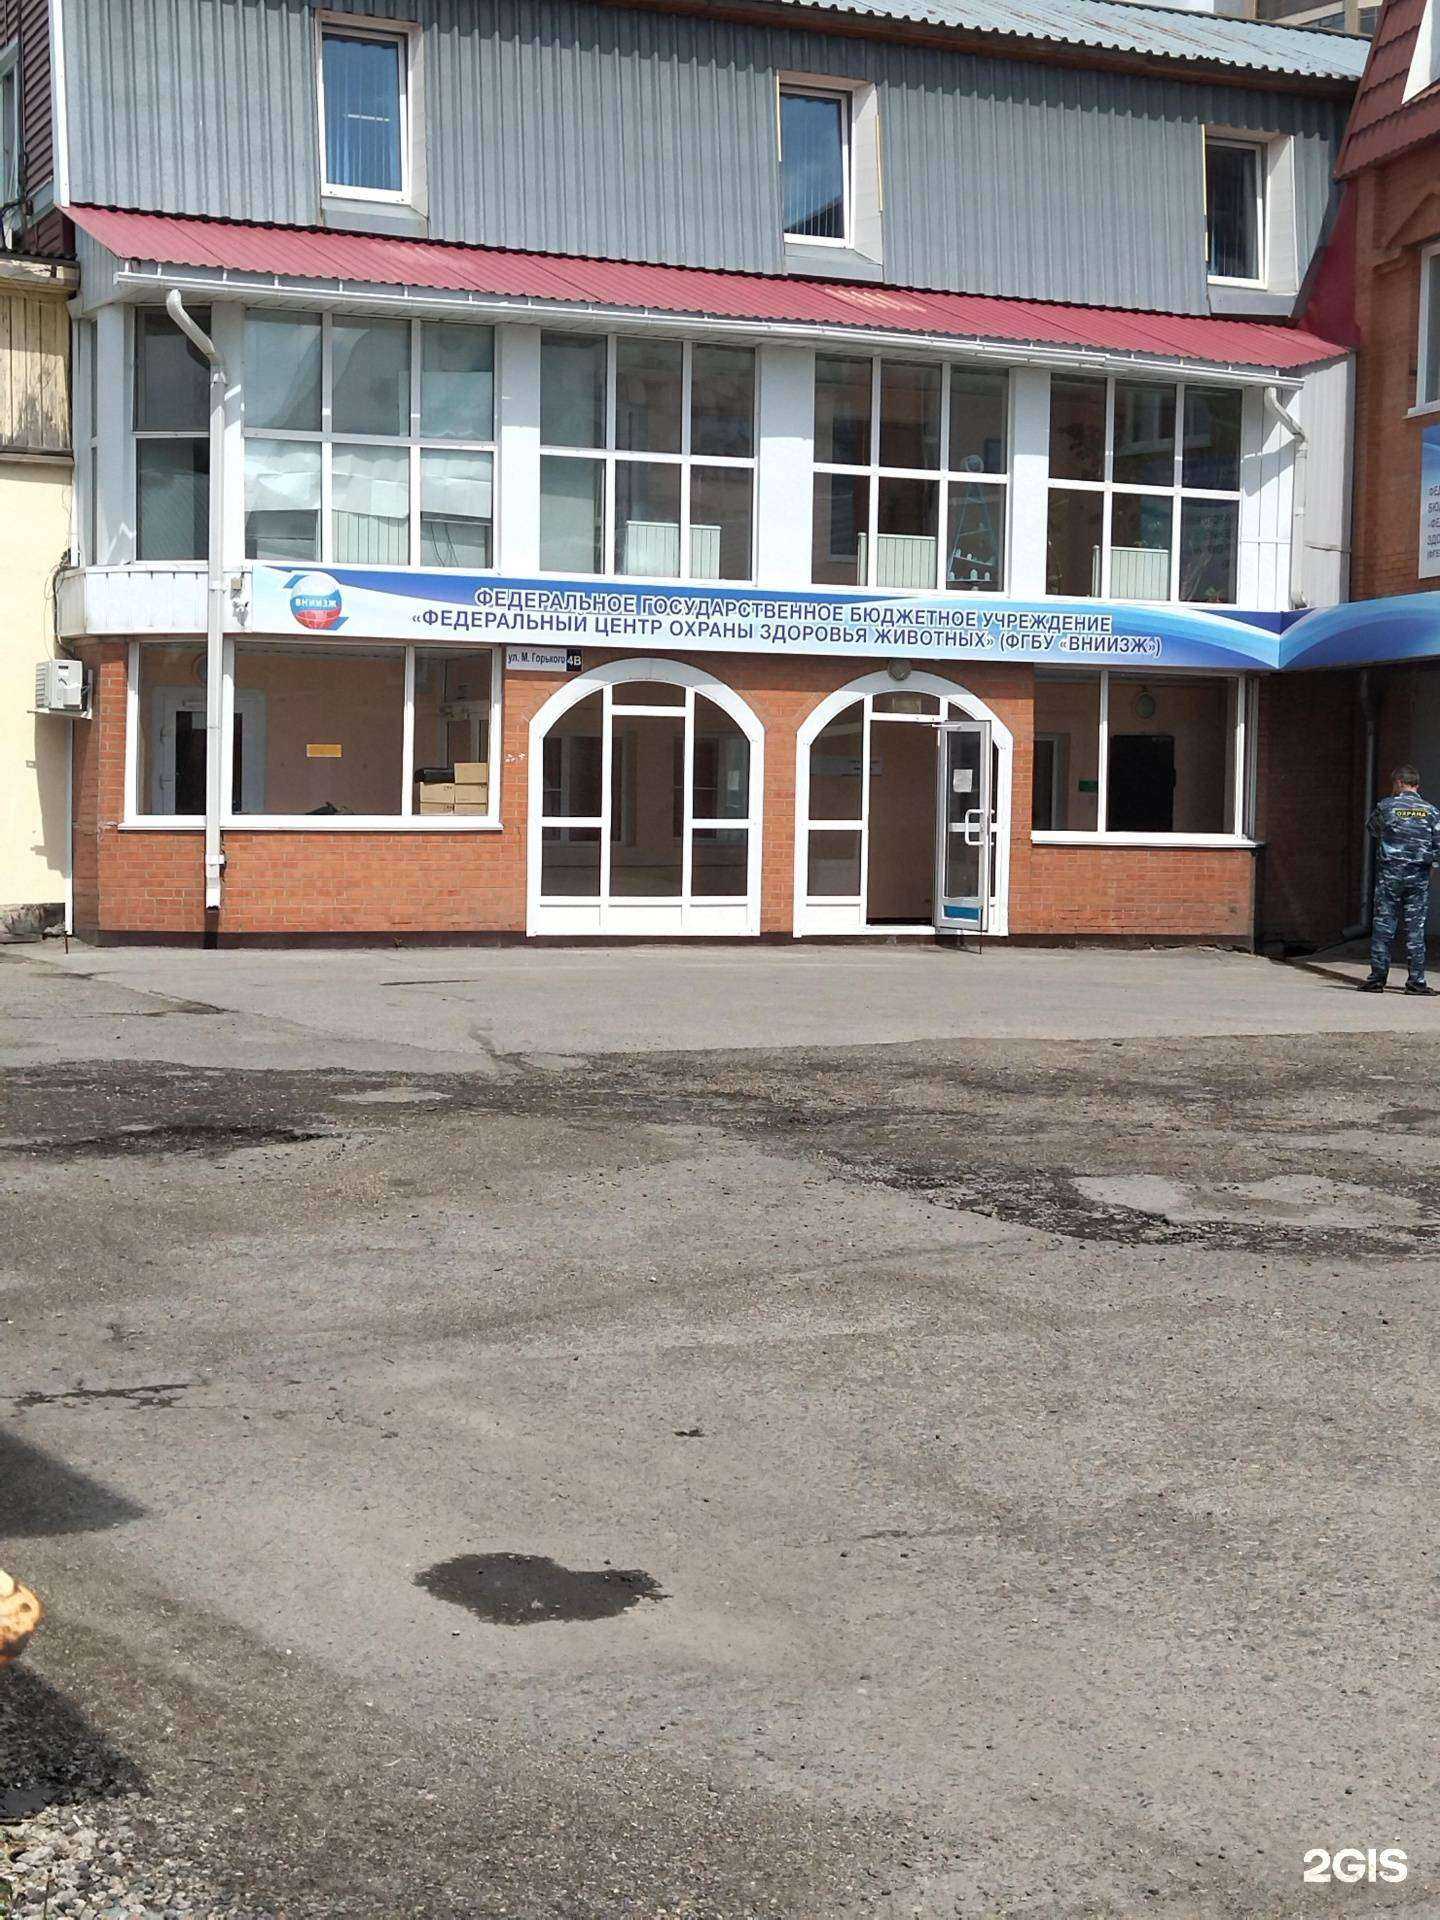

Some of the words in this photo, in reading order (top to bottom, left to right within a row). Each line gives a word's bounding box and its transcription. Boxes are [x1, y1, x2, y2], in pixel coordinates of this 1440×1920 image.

[477, 589, 635, 613] ФЕДЕРАЛЬНОЕ
[642, 596, 843, 622] ГОСУДАРСТВЕННОЕ
[850, 606, 976, 627] БЮДЖЕТНОЕ
[983, 611, 1111, 632] УЧРЕЖДЕНИЕ
[412, 609, 587, 632] «ФЕДЕРАЛЬНЫЙ
[595, 616, 662, 636] ЦЕНТР
[669, 620, 753, 639] ОХРАНЫ
[760, 624, 868, 644] ЗДОРОВЬЯ
[874, 628, 994, 648] ЖИВОТНЫХ»
[1000, 633, 1054, 651] (ФГБУ
[1060, 636, 1162, 657] «ВНИИЗЖ»)
[507, 653, 520, 664] ул.
[521, 652, 530, 662] М.
[531, 652, 566, 664] Горького
